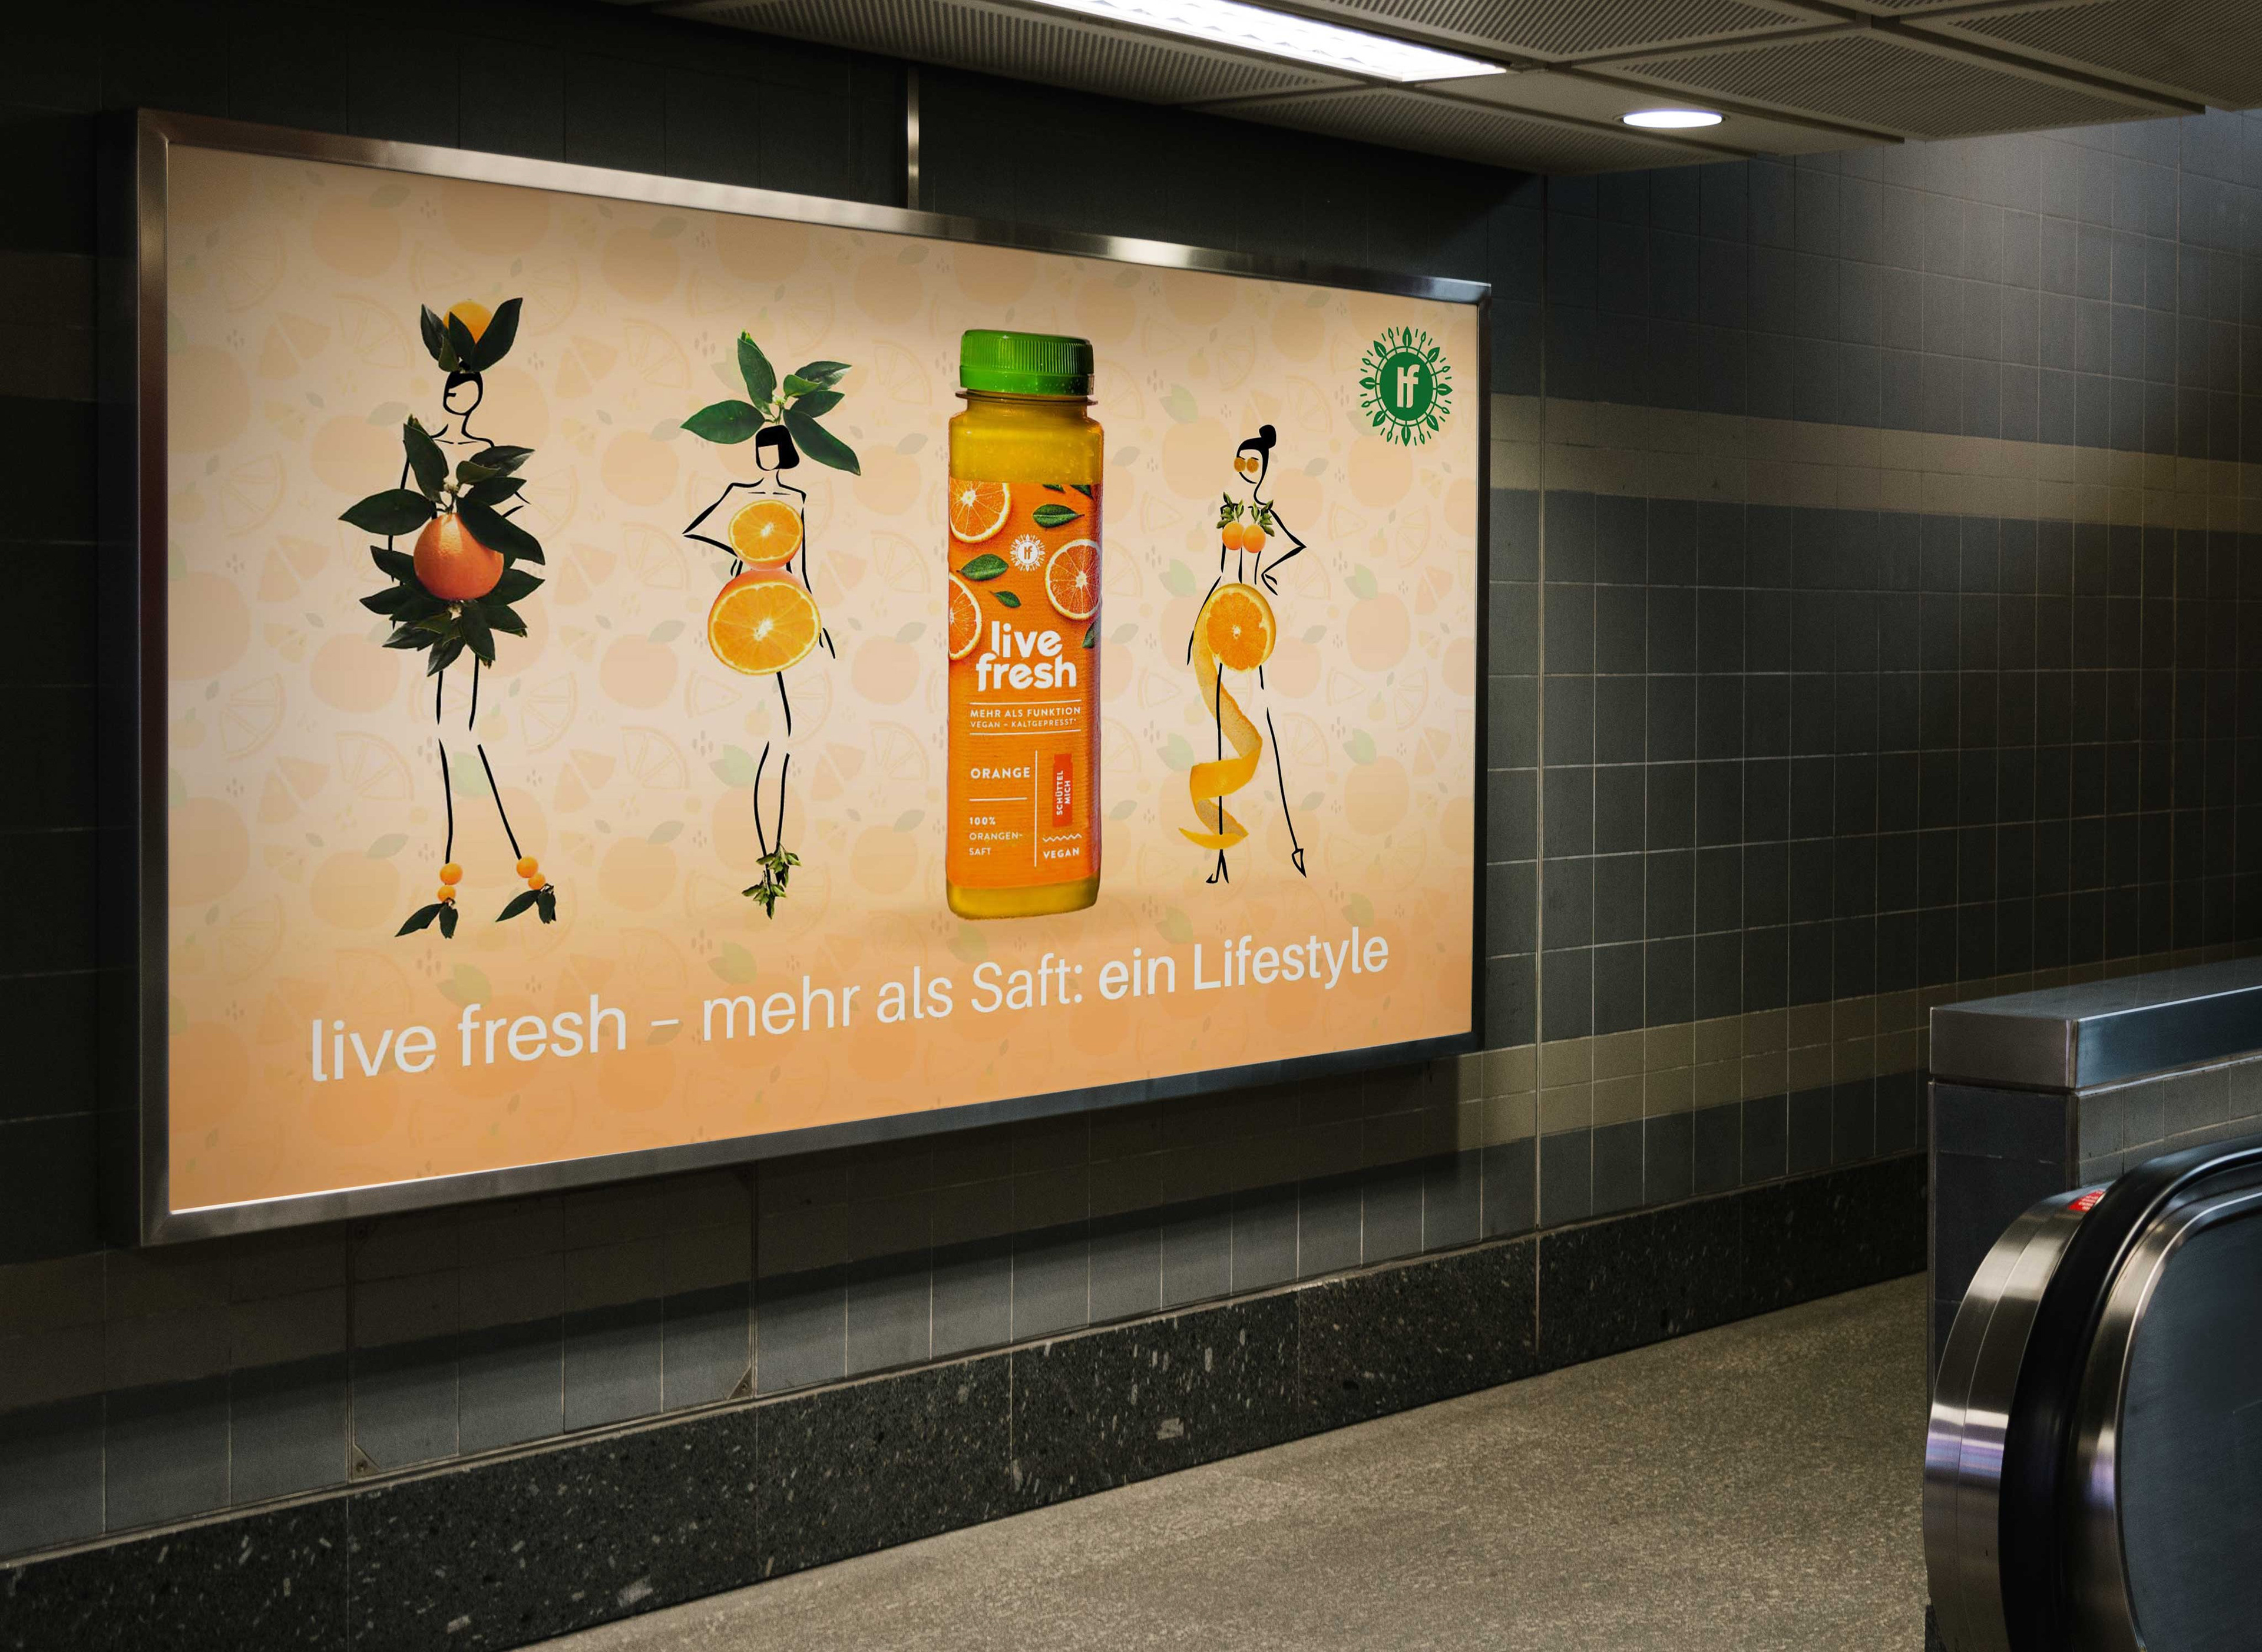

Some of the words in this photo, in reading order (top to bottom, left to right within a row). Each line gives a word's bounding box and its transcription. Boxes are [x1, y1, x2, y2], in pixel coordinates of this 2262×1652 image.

[991, 621, 1062, 658] live
[975, 653, 1077, 691] fresh
[970, 709, 1001, 717] MEHR
[1004, 709, 1023, 717] ALS
[1027, 707, 1081, 717] FUNKTION
[970, 767, 1030, 779] ORANGE
[969, 816, 996, 825] 100%
[969, 832, 1023, 840] ORANGEN-
[969, 847, 991, 856] SAFT
[1043, 847, 1080, 859] VEGAN
[312, 1019, 436, 1081] live
[458, 994, 626, 1067] fresh
[703, 975, 861, 1041] mehr
[877, 965, 953, 1023] als
[971, 952, 1083, 1012] Saft:
[1099, 947, 1176, 1000] ein
[1194, 926, 1389, 989] Lifestyle
